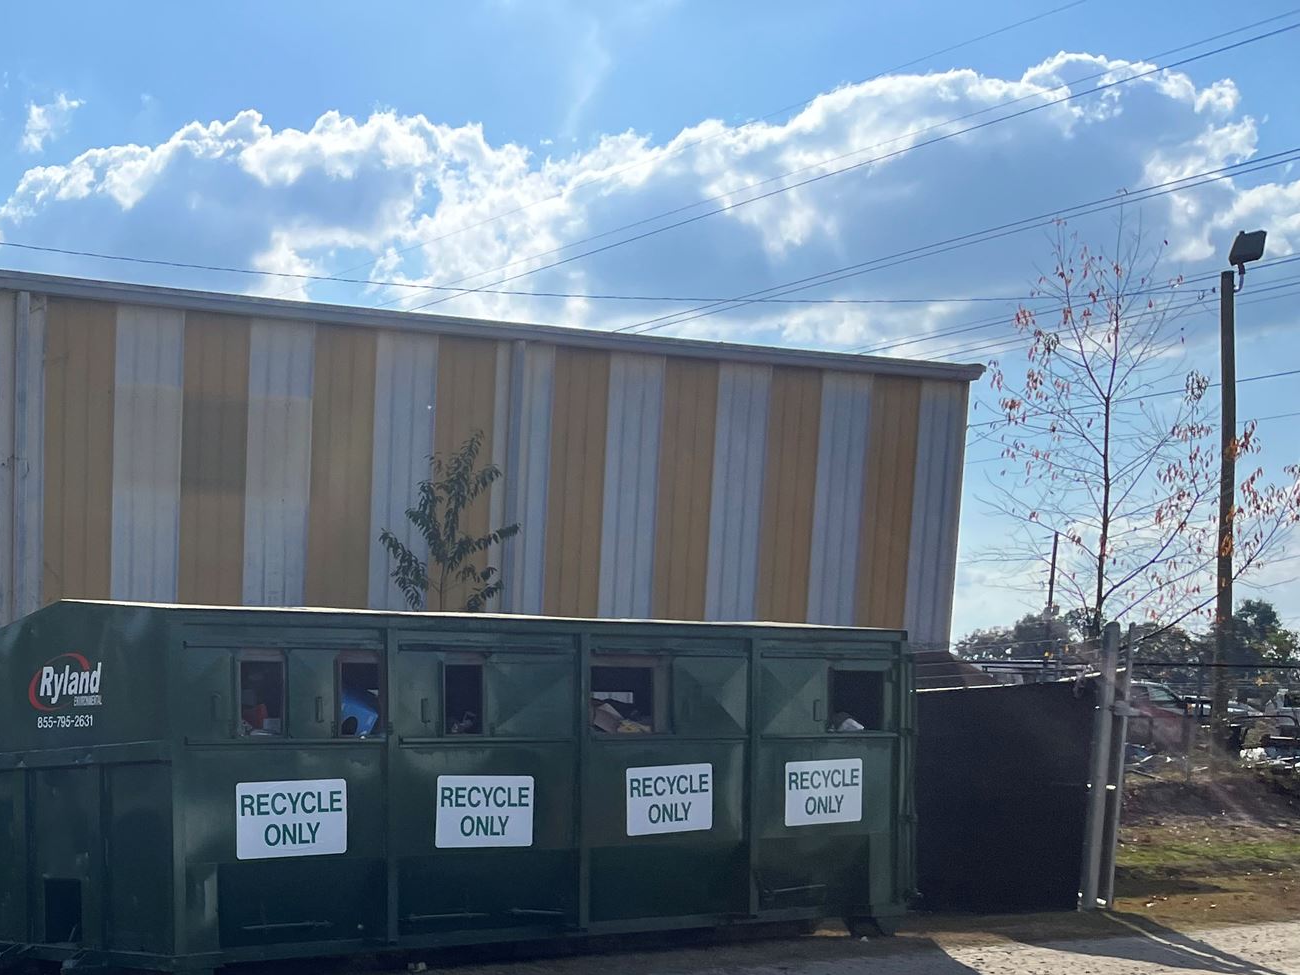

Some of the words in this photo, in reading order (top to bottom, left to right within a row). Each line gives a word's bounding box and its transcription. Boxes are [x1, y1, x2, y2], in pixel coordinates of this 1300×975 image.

[40, 662, 102, 704] Ryland
[37, 715, 93, 728] 855-795-2631
[630, 774, 709, 798] RECYCLE
[788, 768, 859, 790] RECYCLE
[241, 791, 342, 816] RECYCLE
[441, 786, 529, 808] RECYCLE
[805, 795, 844, 815] ONLY
[648, 801, 692, 824] ONLY
[264, 822, 320, 846] ONLY
[460, 815, 509, 837] ONLY
